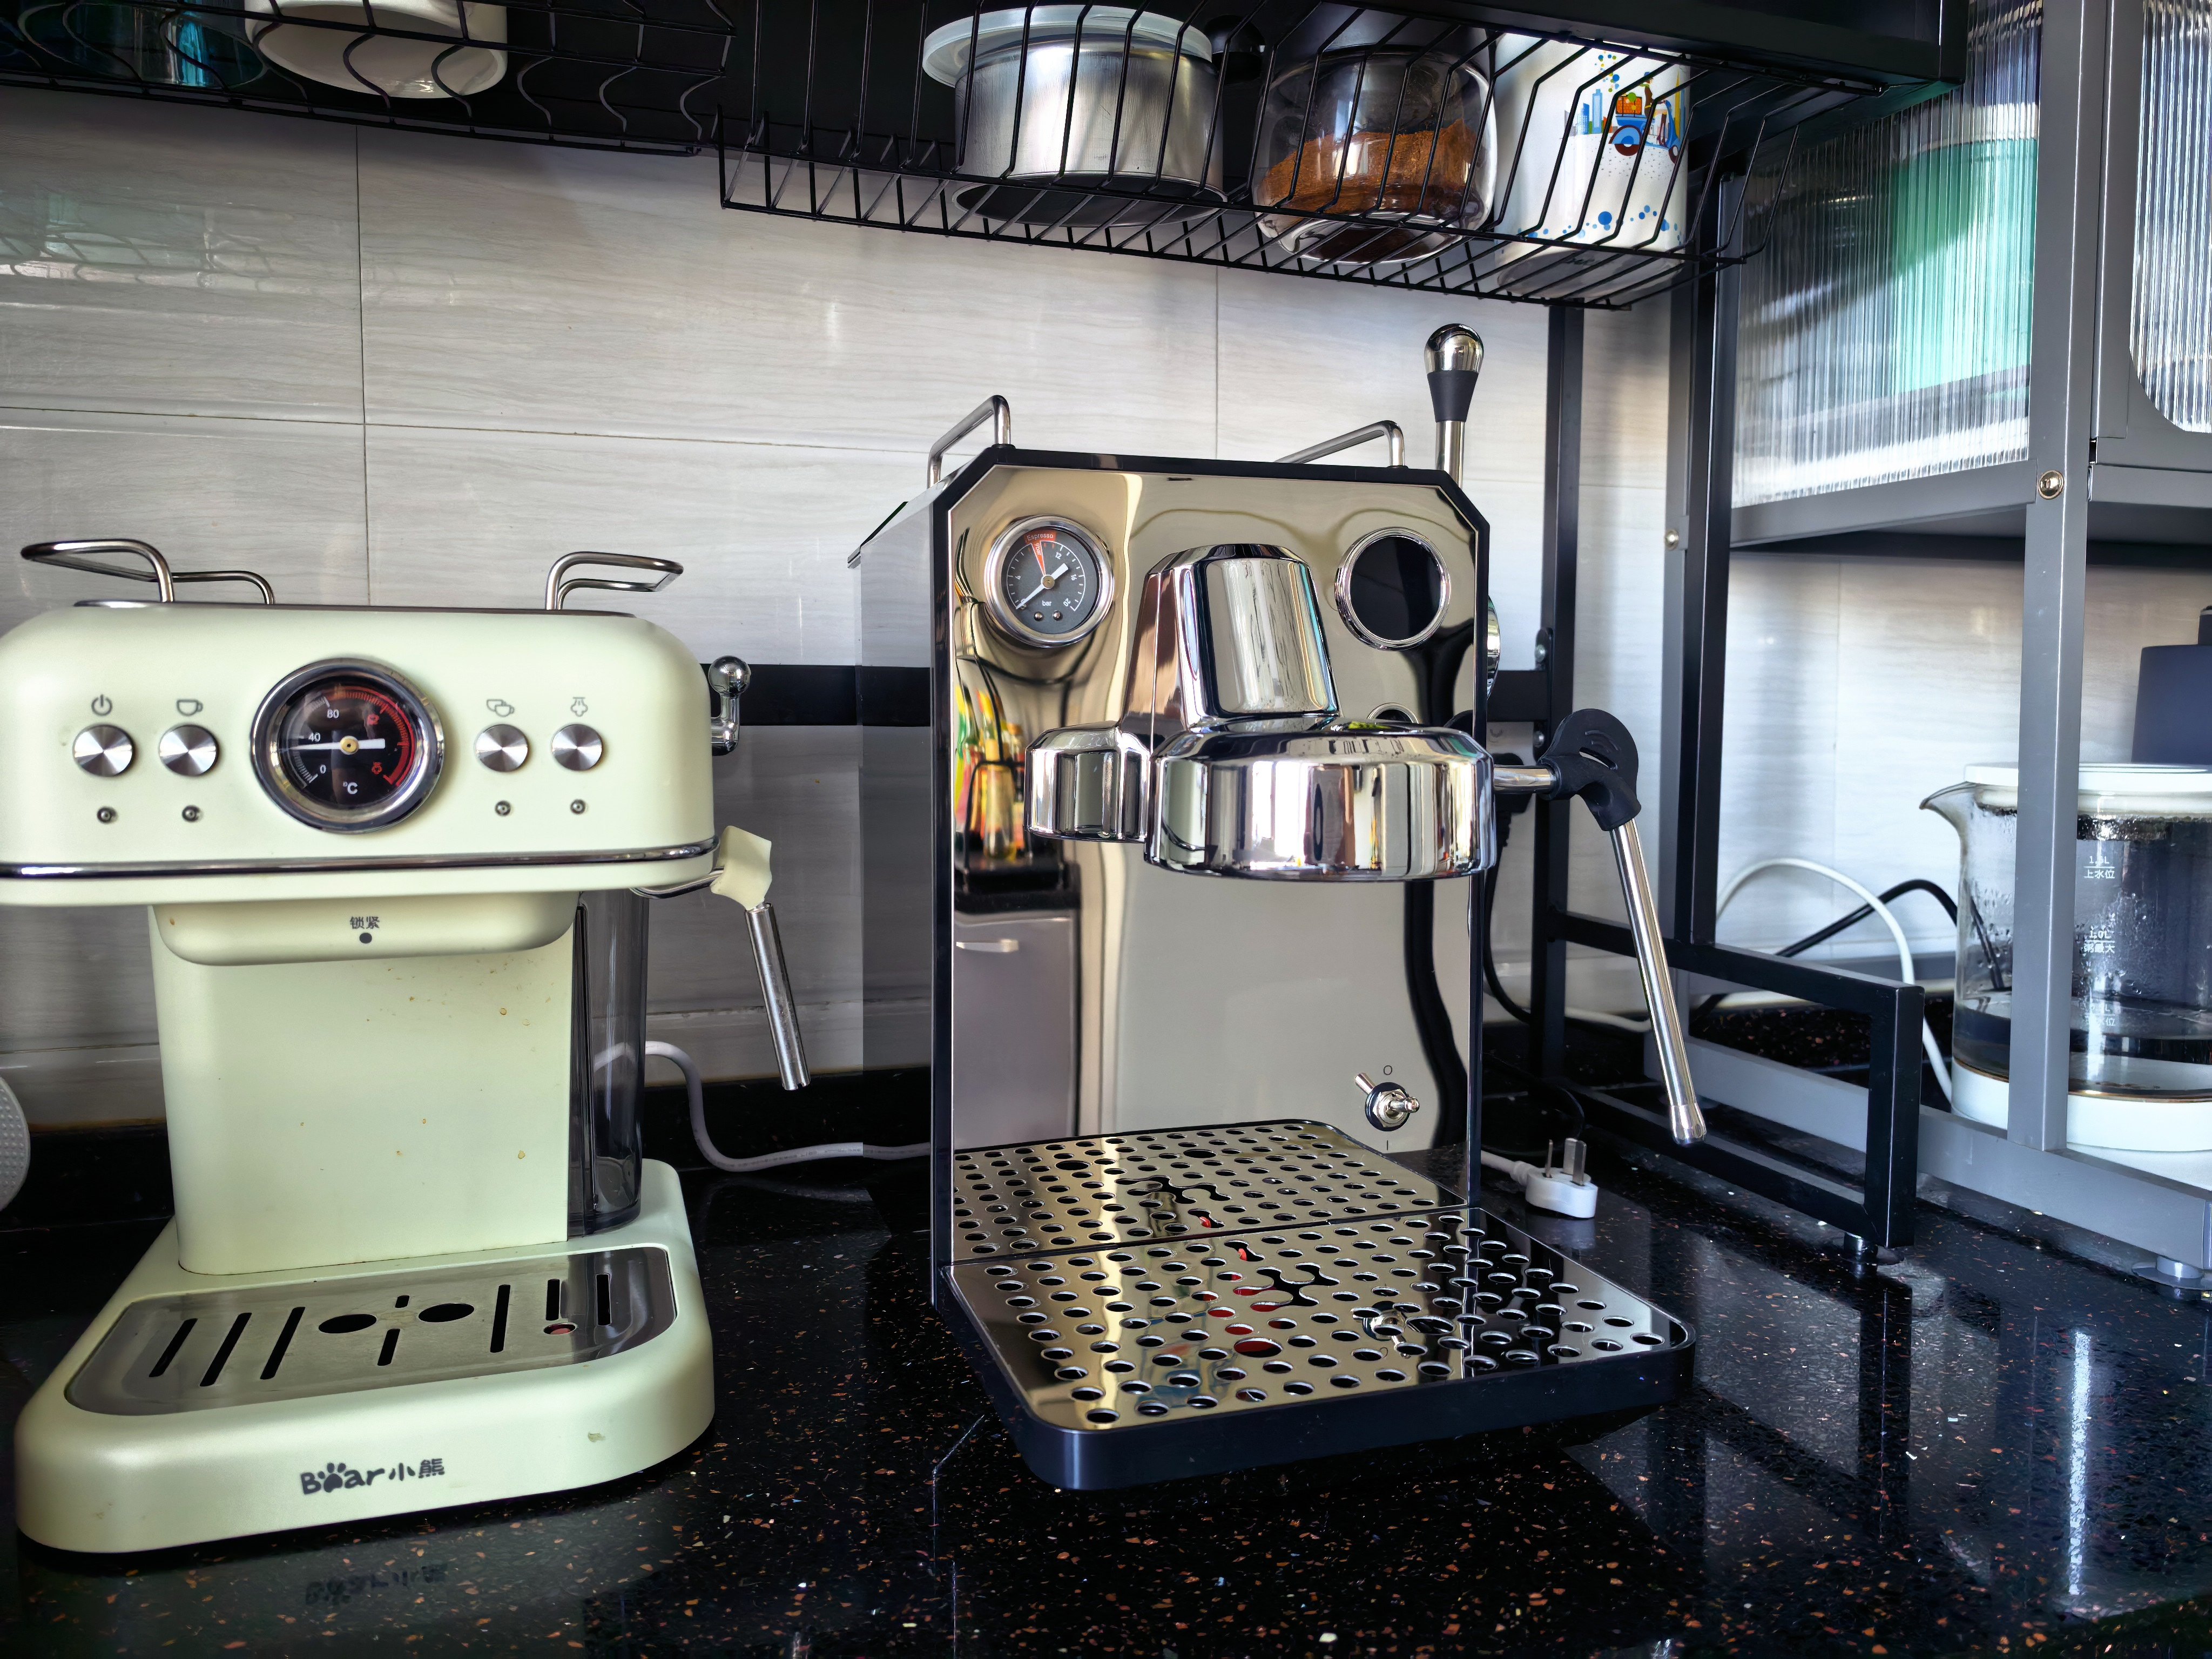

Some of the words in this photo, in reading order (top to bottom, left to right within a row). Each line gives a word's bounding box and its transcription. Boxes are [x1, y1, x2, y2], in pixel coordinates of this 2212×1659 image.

[1063, 598, 1071, 607] 20
[327, 709, 339, 719] 80
[308, 732, 321, 743] 40
[320, 765, 326, 774] 0
[2083, 869, 2115, 879] 上水位
[350, 916, 380, 929] 锁紧
[2089, 930, 2112, 939] 1.0L
[300, 1462, 385, 1494] Bar
[388, 1458, 445, 1482] 小熊
